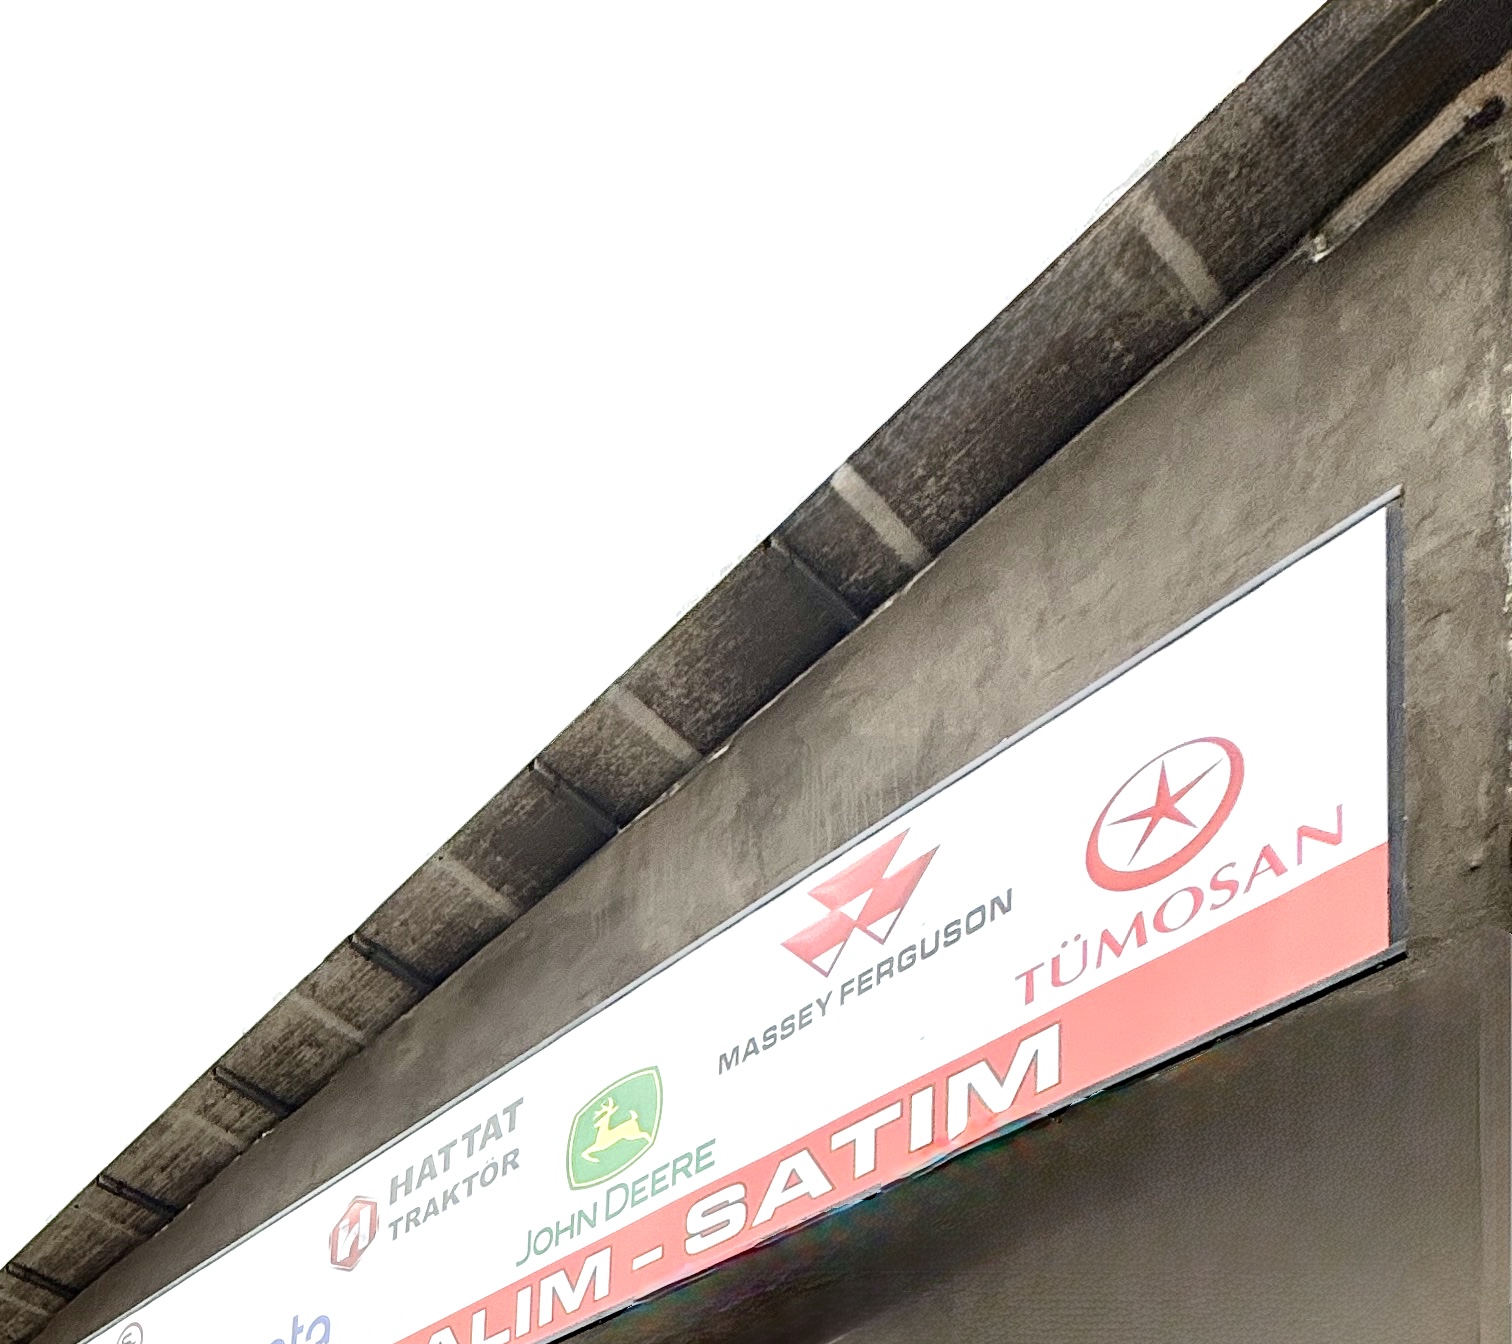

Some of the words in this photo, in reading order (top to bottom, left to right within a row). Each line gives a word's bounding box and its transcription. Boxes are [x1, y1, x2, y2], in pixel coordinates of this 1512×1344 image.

[717, 991, 834, 1076] MASSEY
[838, 887, 1014, 1006] FERGUSON
[1014, 803, 1344, 1006] TÜMOSAN
[387, 1146, 521, 1241] TRAKTÖR
[388, 1097, 524, 1205] HATTAT
[516, 1200, 598, 1268] JOHN
[604, 1138, 717, 1219] DEERE
[683, 1020, 1064, 1257] SATIM
